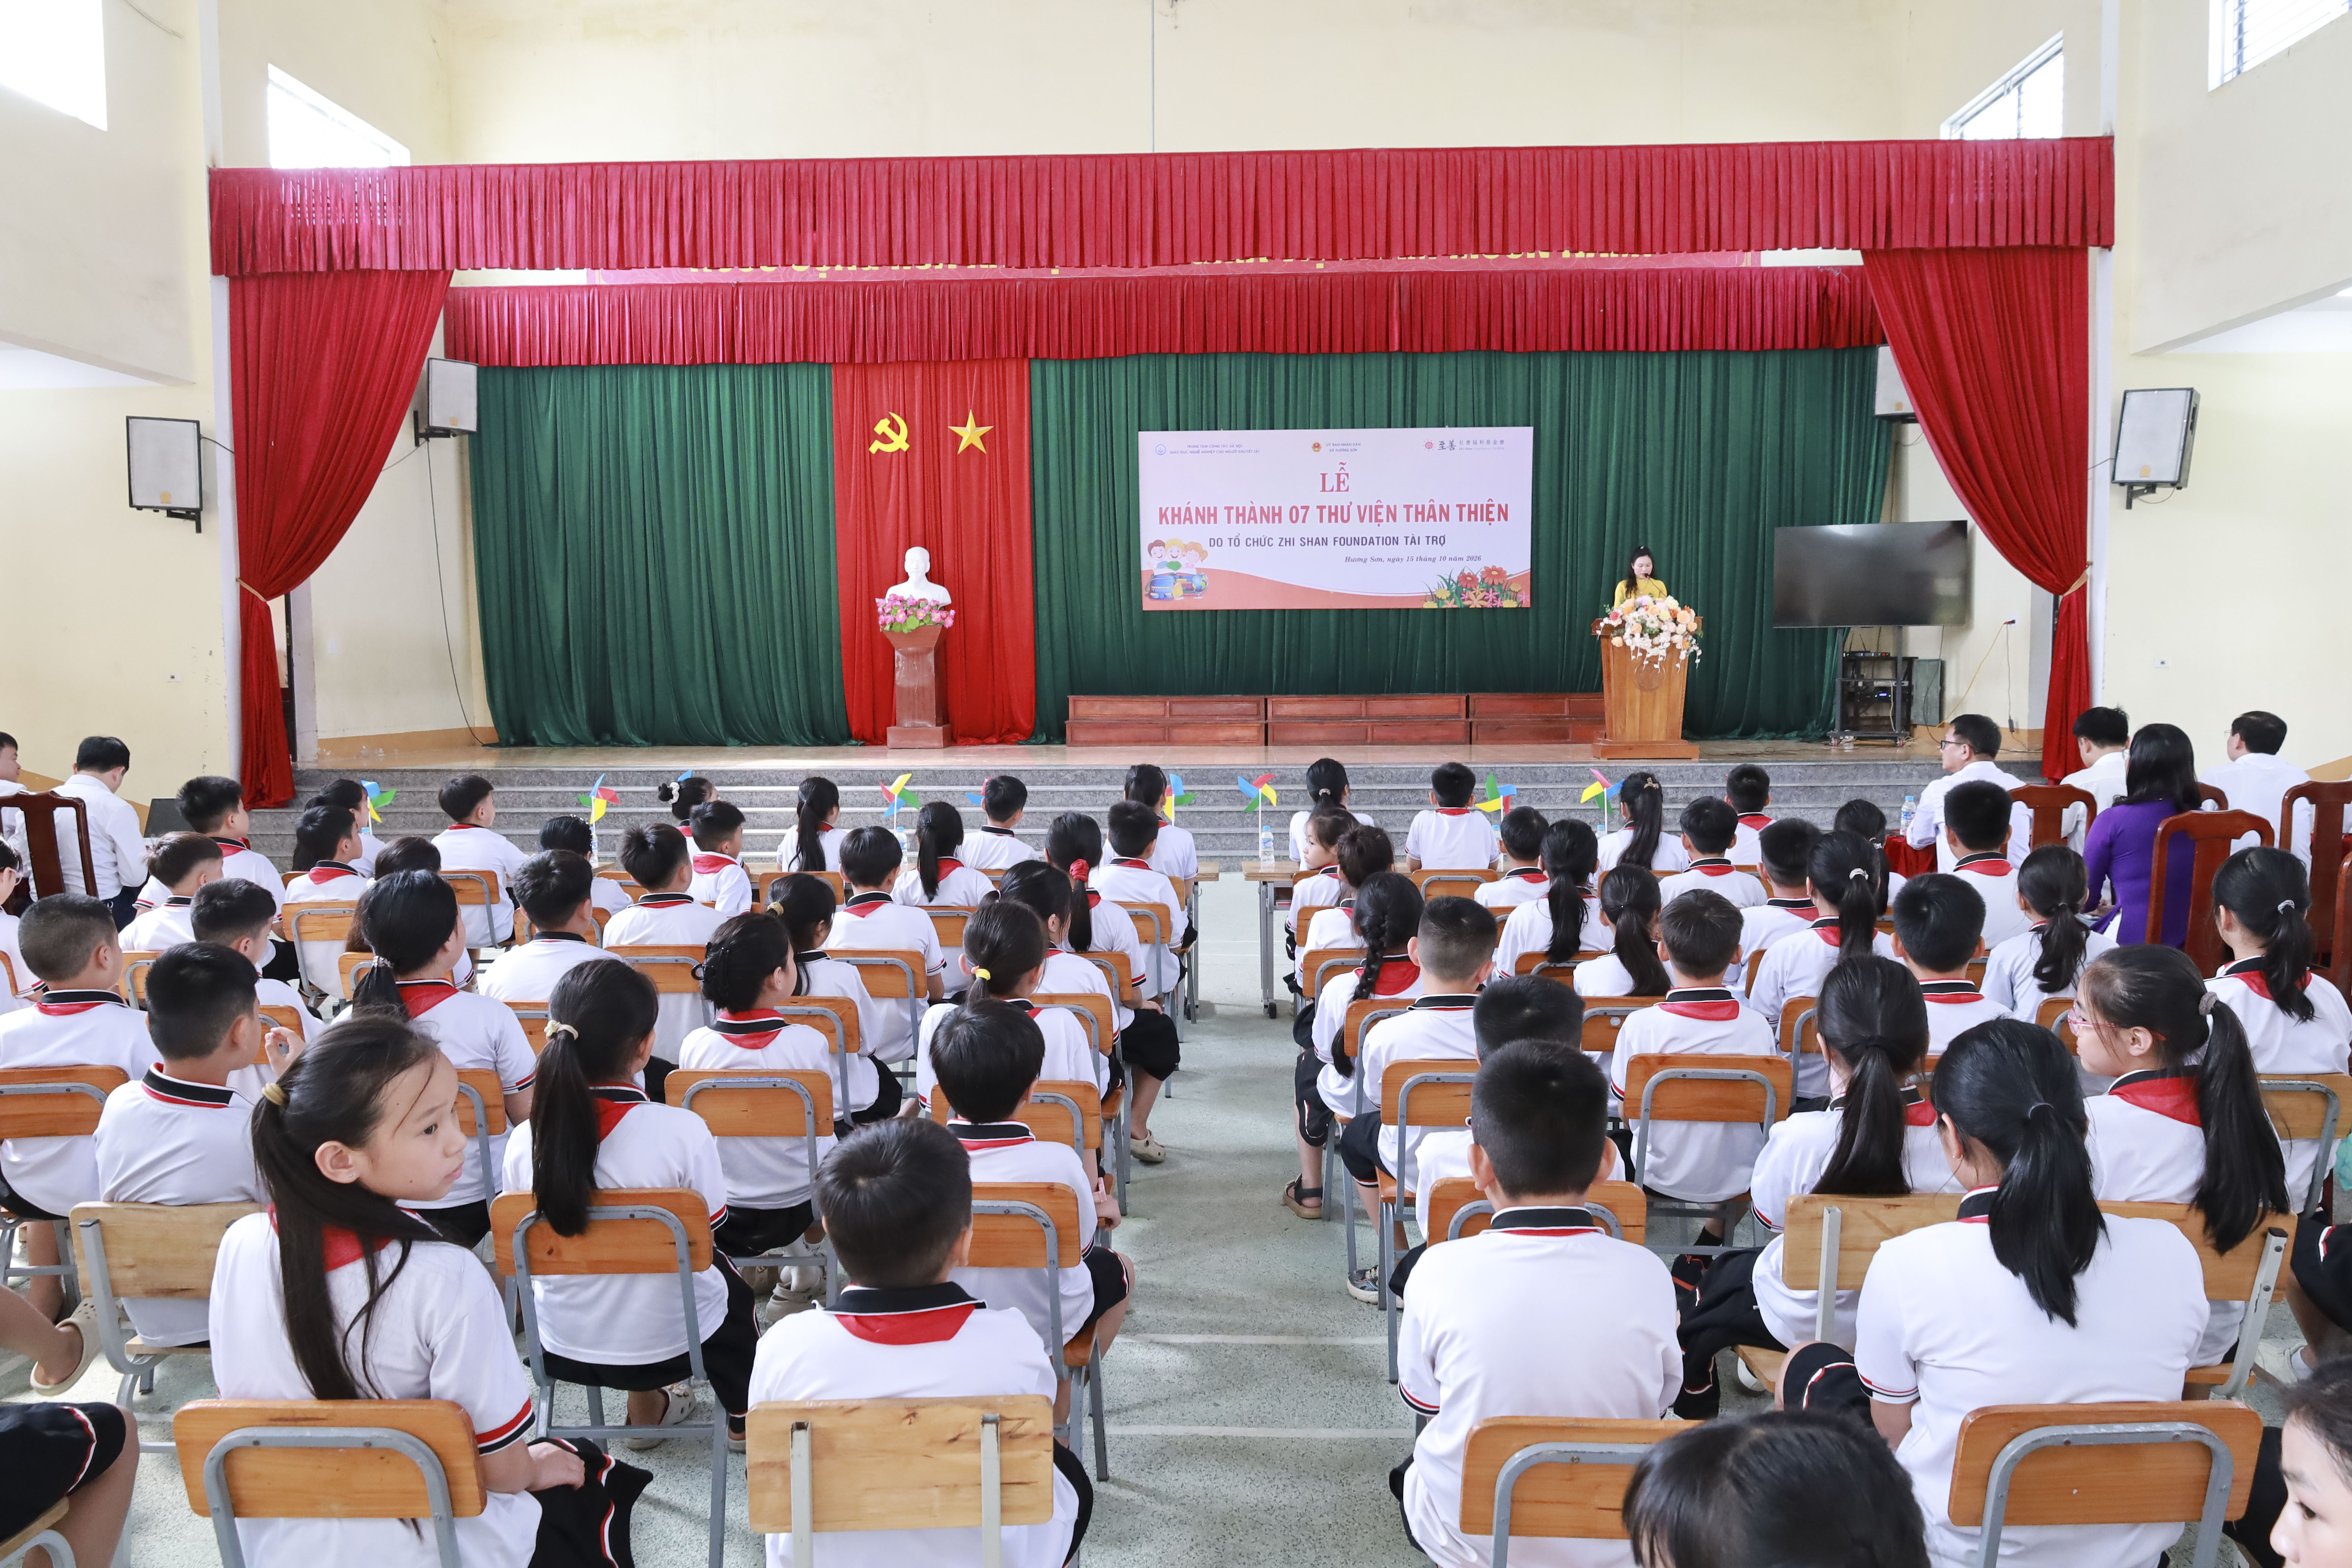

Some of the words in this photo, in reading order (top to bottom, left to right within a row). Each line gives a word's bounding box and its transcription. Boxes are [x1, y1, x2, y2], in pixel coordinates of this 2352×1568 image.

[1438, 439, 1456, 451] 至善
[1320, 462, 1349, 492] LỄ
[1159, 501, 1217, 525] KHÁNH
[1224, 501, 1282, 524] THÀNH
[1289, 505, 1310, 524] 07
[1316, 501, 1352, 523] THƯ
[1357, 499, 1397, 527] VIỆN
[1403, 499, 1449, 522] THÂN
[1456, 498, 1508, 526] THIỆN
[1209, 537, 1223, 547] DO
[1228, 533, 1240, 547] TỔ
[1245, 535, 1274, 547] CHỨC
[1278, 537, 1295, 547] ZHI
[1300, 537, 1328, 547] SHAN
[1333, 536, 1399, 546] FOUNDATION
[1404, 534, 1420, 545] TÀI
[1425, 534, 1446, 547] TRỢ
